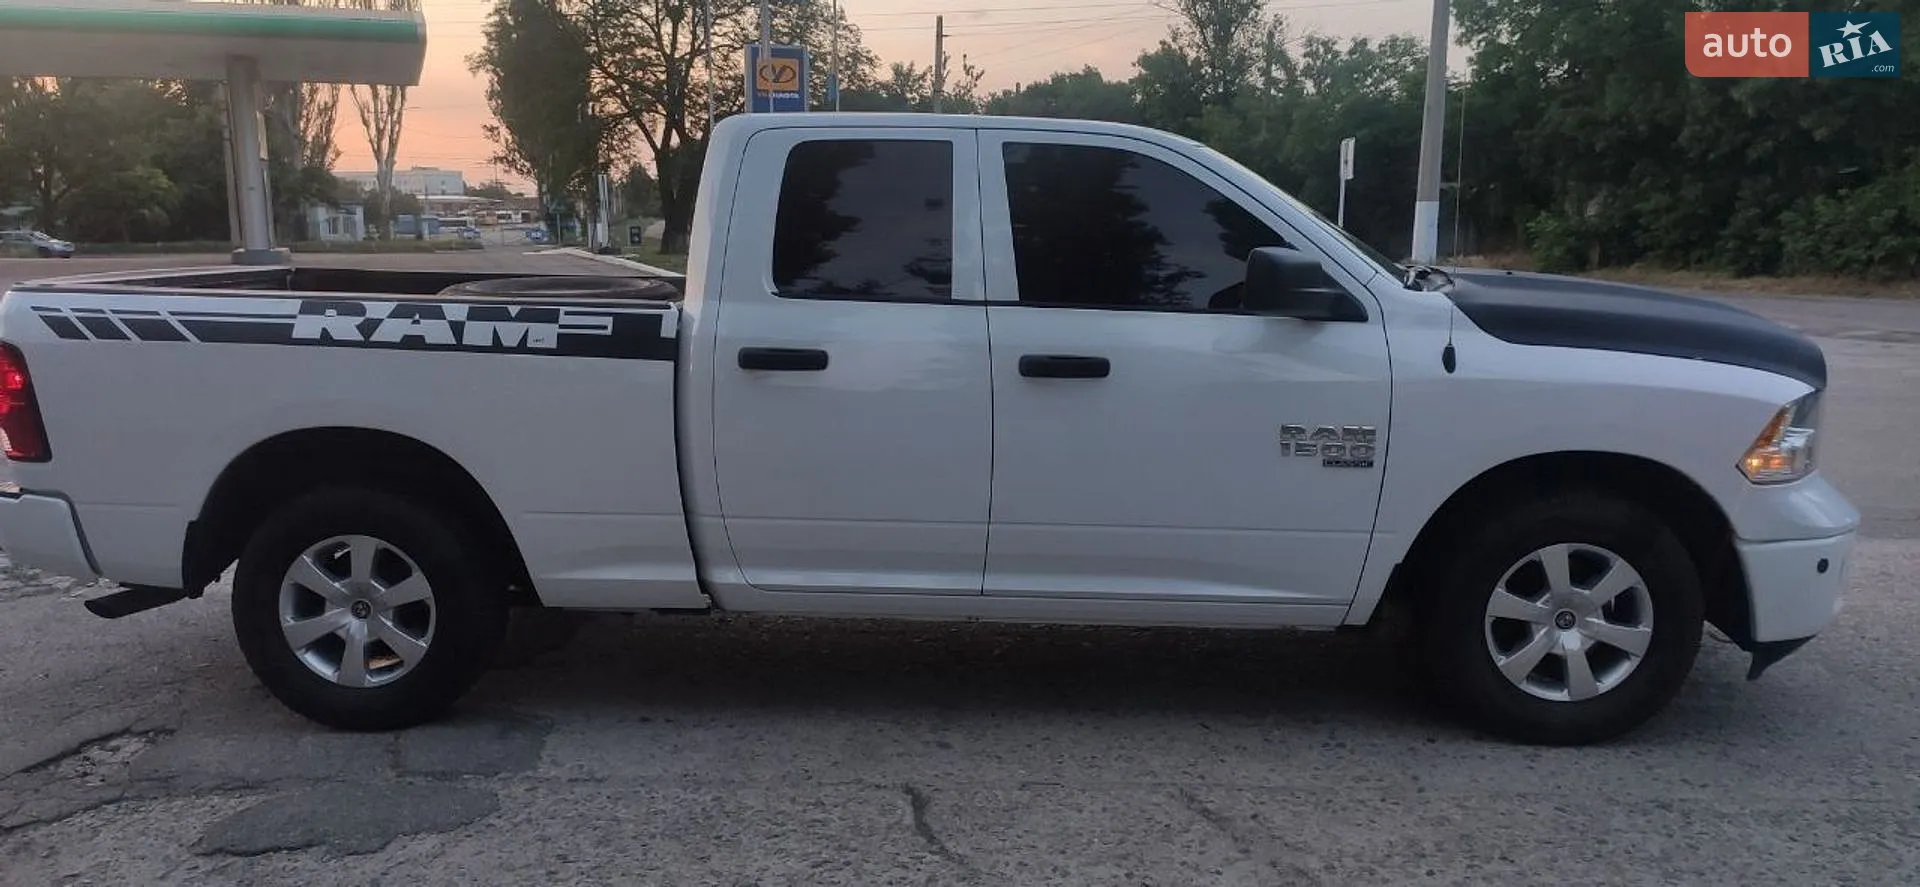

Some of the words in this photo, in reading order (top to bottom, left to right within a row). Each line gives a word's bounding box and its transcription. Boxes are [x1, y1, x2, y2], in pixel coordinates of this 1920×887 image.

[292, 301, 559, 349] RAM
[1279, 424, 1377, 442] RAM
[1279, 441, 1375, 458] 1500
